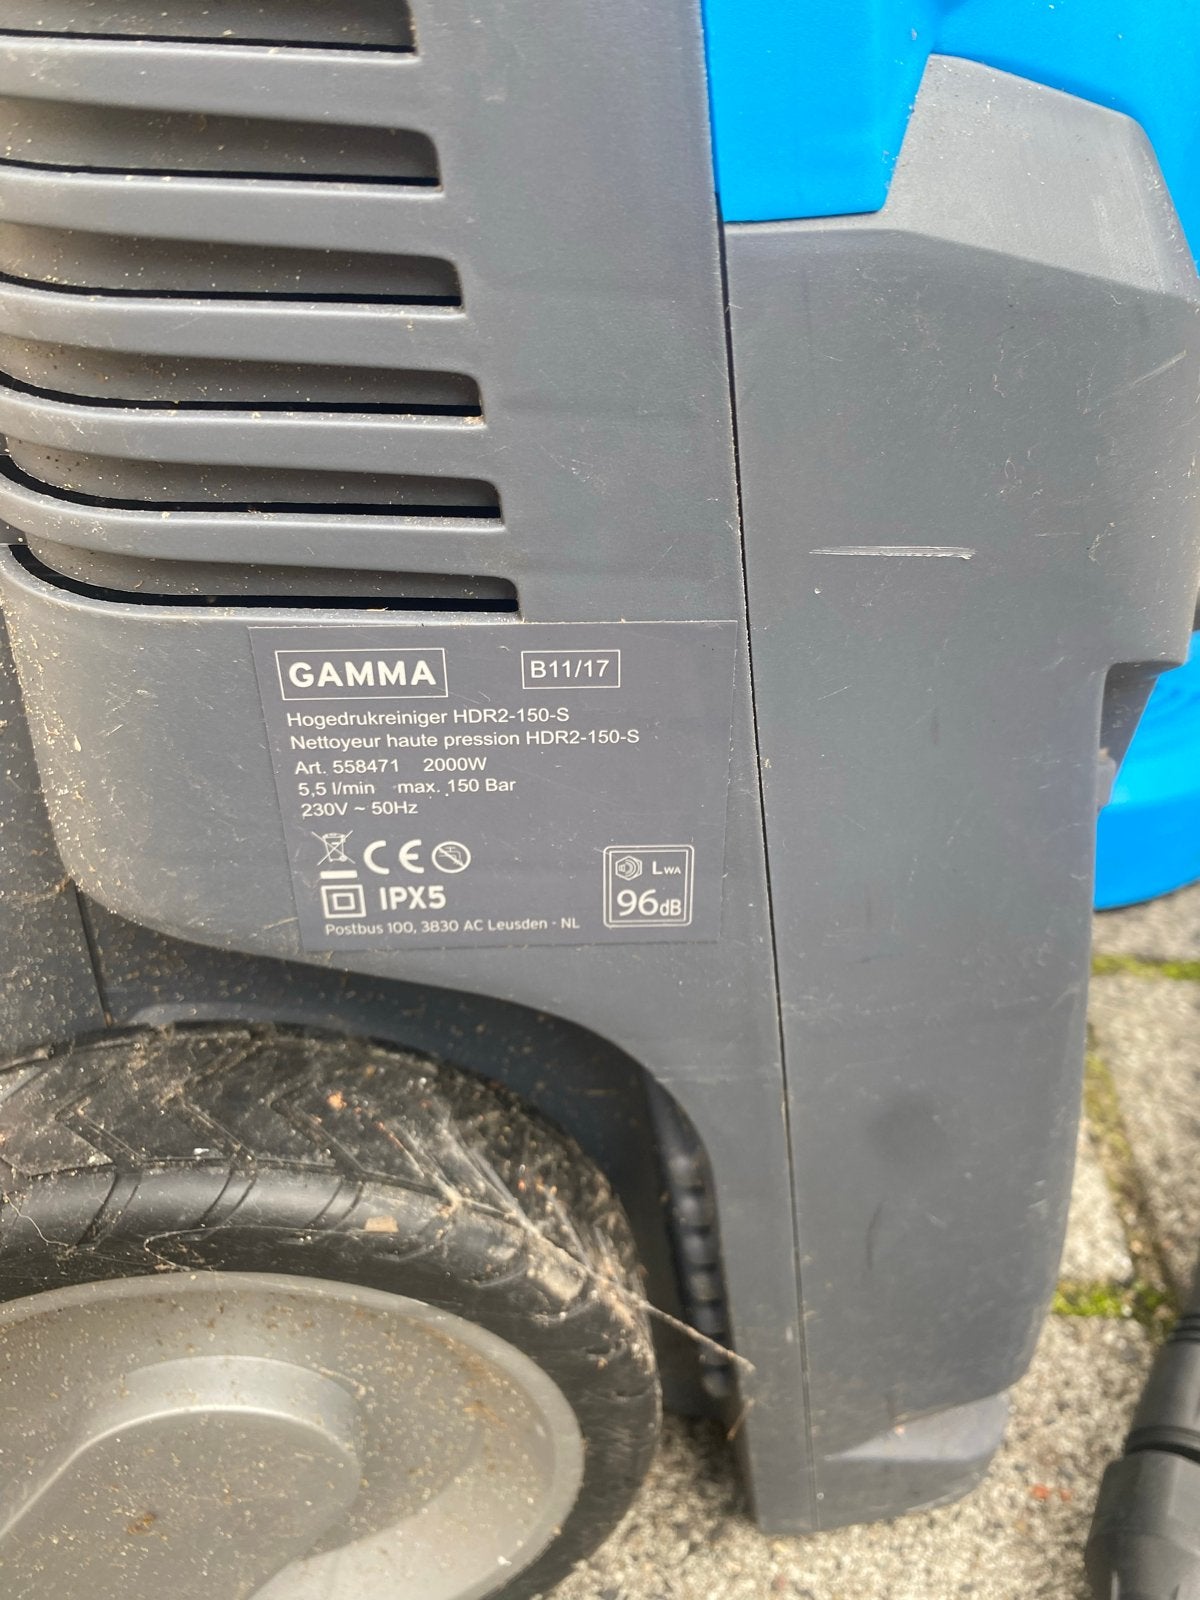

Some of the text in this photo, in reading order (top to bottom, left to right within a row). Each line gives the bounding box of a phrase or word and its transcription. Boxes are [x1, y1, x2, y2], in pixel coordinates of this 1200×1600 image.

[289, 660, 437, 688] GAMMA
[530, 659, 610, 679] B11/17
[287, 707, 569, 730] Hogedrukreiniger HDR2-150-S
[290, 729, 640, 752] Nettoyeur haute pression HDR2-150-S
[294, 757, 487, 775] Art. 558471 2000W
[298, 778, 516, 798] 5,5 l/min max. 150 Bar
[301, 802, 348, 817] 230V
[371, 801, 418, 815] 50Hz
[363, 839, 425, 875] CE
[379, 885, 447, 911] IPX5
[616, 888, 682, 917] 96dB
[325, 922, 384, 936] Postbus
[387, 921, 417, 935] 100,
[420, 920, 459, 933] 3830
[463, 919, 483, 932] AC
[488, 917, 548, 931] Leusden
[561, 917, 580, 930] NL
